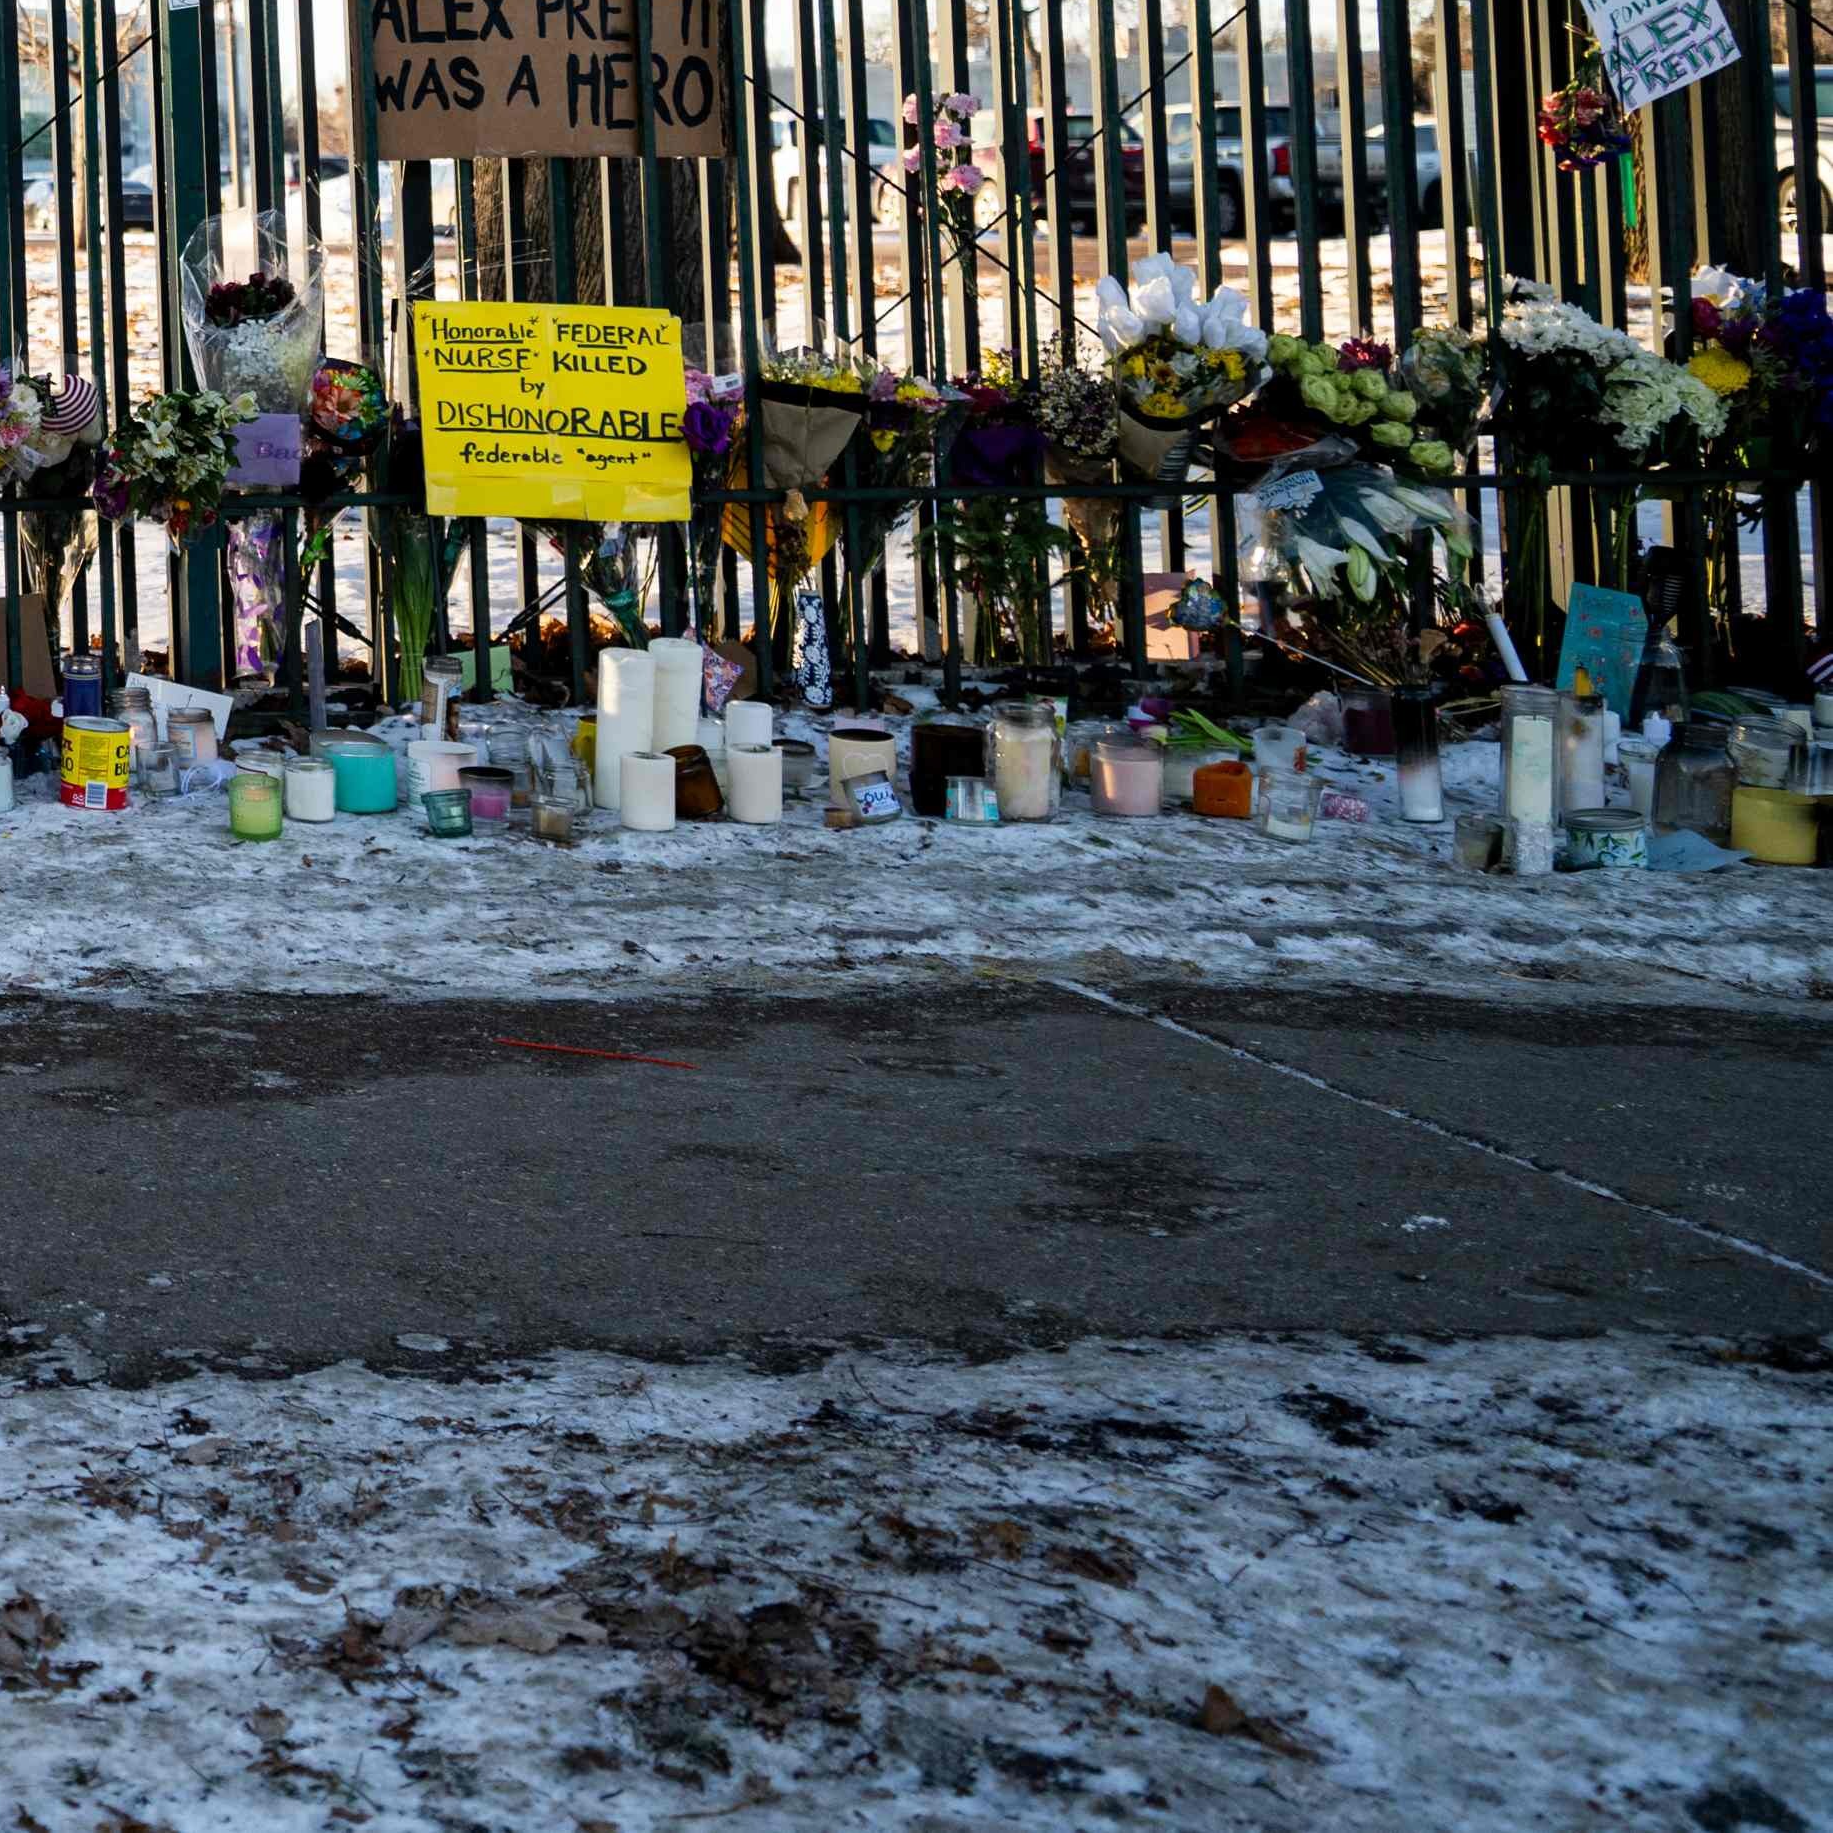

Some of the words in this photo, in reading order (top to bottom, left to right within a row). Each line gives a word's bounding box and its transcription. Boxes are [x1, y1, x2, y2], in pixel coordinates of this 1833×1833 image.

[1619, 24, 1736, 109] PRETTI
[375, 56, 485, 112] WAS
[506, 54, 541, 109] A
[566, 52, 715, 130] HERO
[552, 351, 648, 376] KILLED
[520, 376, 546, 399] by
[437, 400, 682, 440] DISHONORABLE
[459, 442, 563, 465] federable
